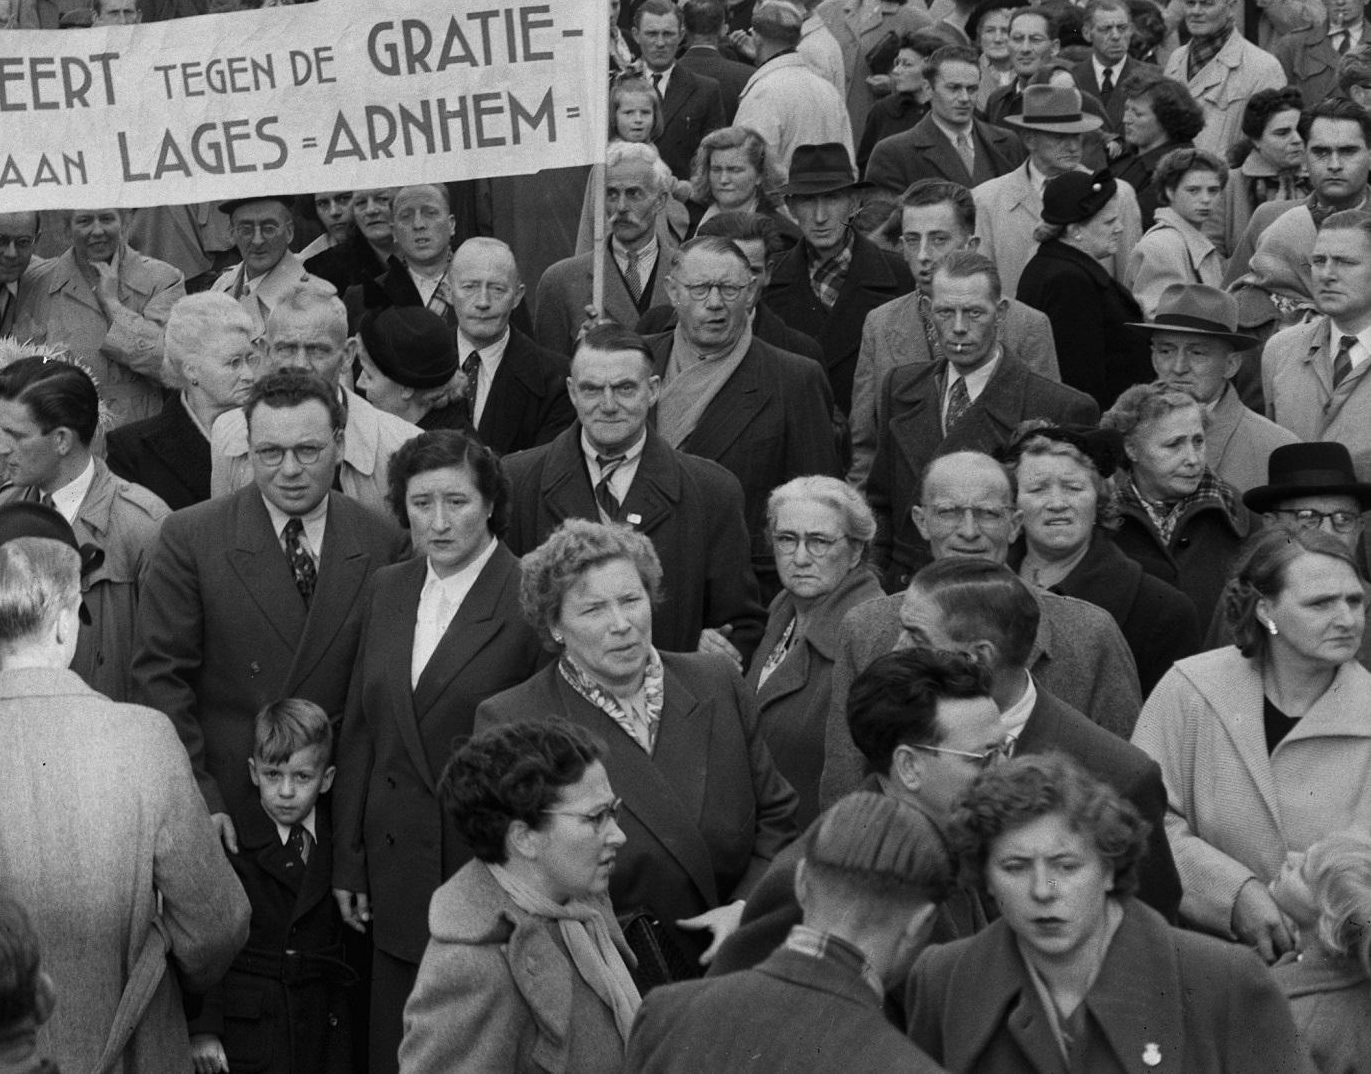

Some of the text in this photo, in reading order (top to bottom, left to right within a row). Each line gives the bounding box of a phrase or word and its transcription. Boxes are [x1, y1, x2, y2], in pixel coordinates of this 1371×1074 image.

[153, 53, 277, 100] TEGEN
[289, 46, 337, 87] DE
[367, 4, 584, 77] GRATIE-
